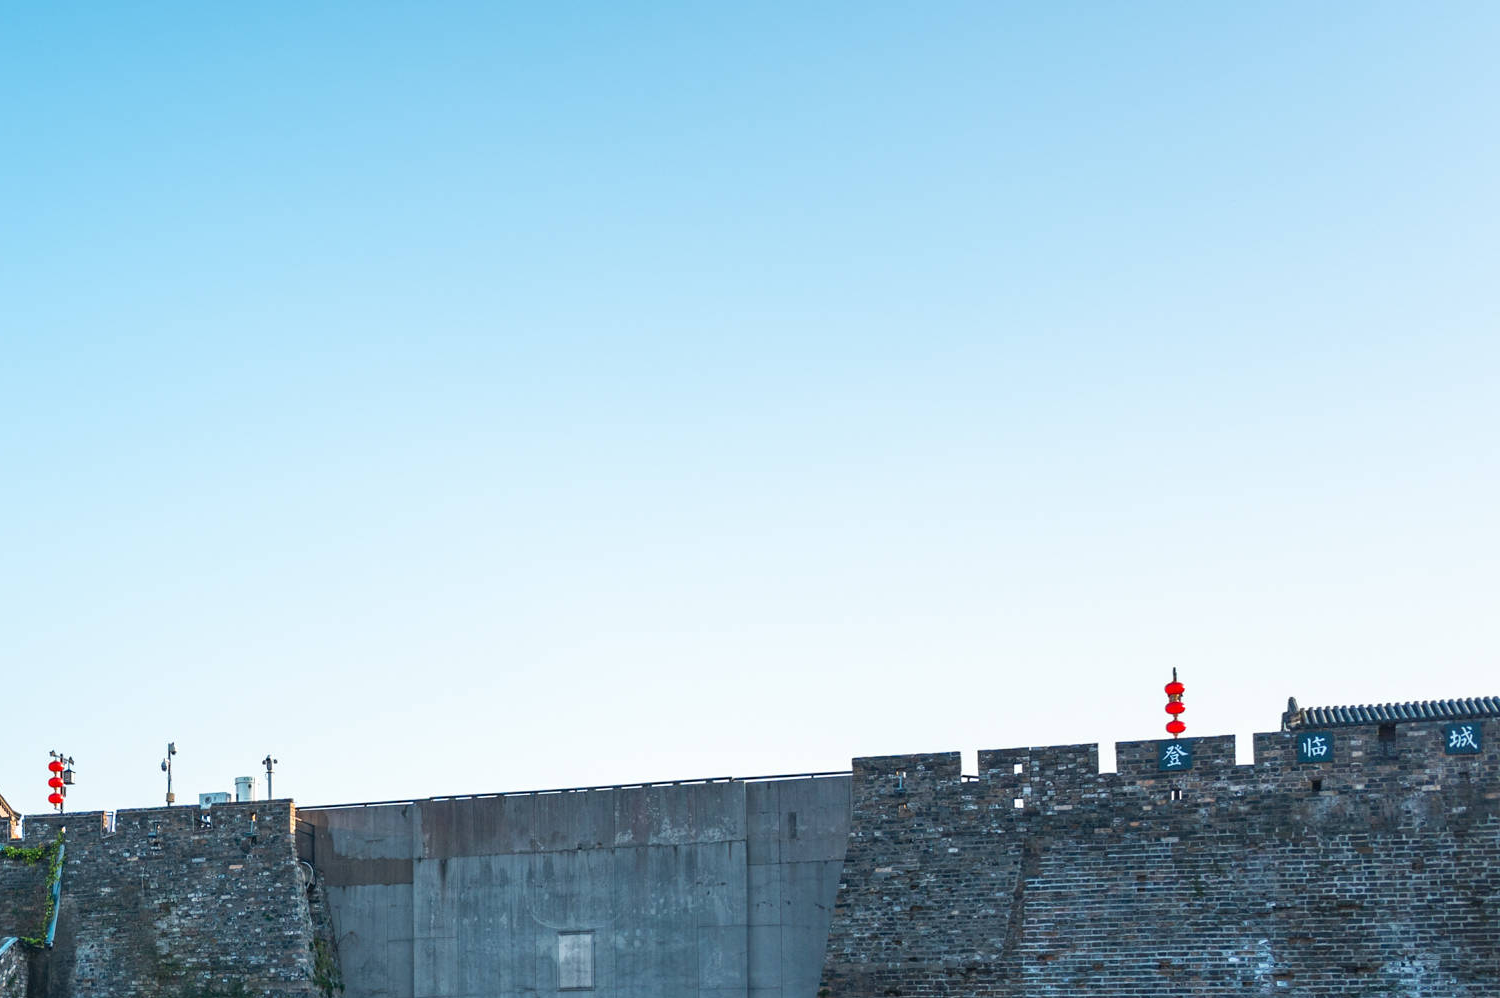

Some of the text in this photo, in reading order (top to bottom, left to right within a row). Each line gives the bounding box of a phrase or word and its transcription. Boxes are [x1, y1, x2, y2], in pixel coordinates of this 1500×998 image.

[1163, 726, 1478, 767] 登 临 城
